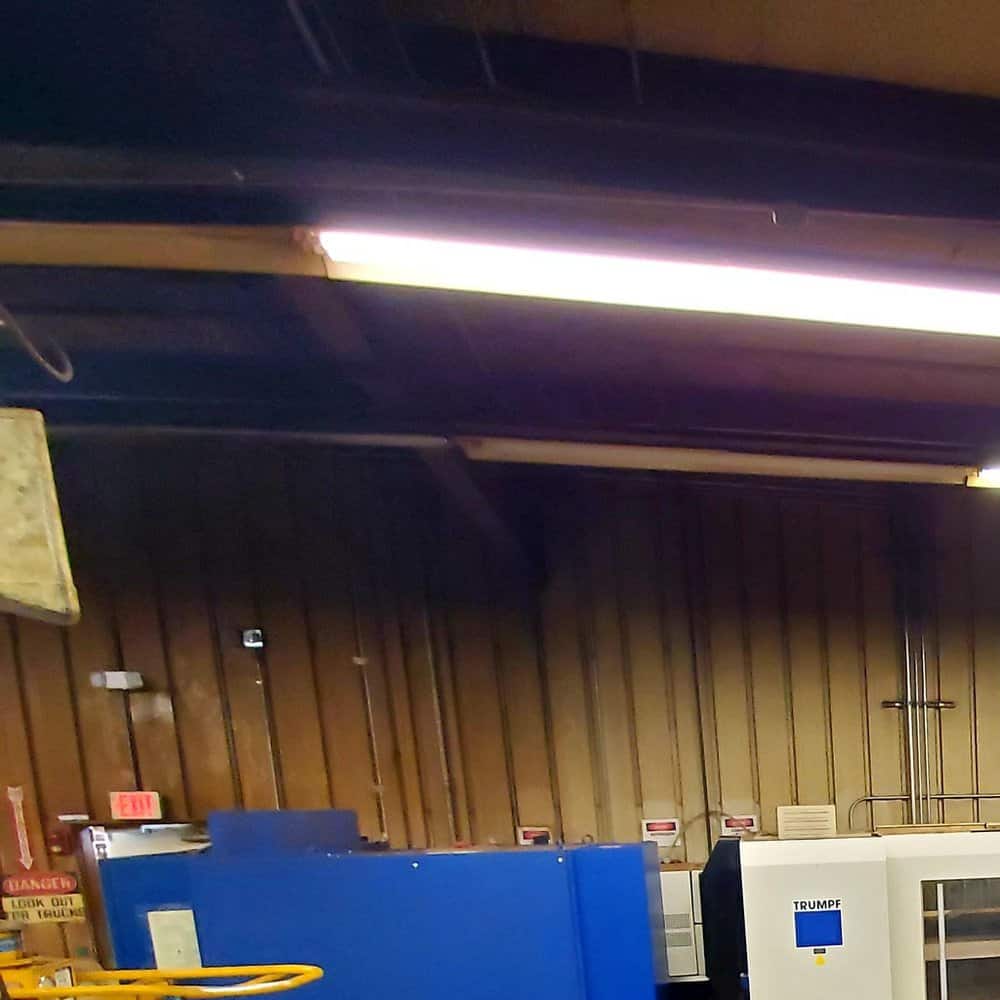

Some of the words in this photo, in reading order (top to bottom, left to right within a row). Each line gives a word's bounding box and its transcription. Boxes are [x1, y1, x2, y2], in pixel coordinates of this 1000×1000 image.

[119, 794, 154, 817] EXIT
[9, 877, 70, 891] DANGER
[11, 897, 44, 909] LOOK
[51, 896, 73, 907] OUT
[793, 899, 841, 910] TRUMPF
